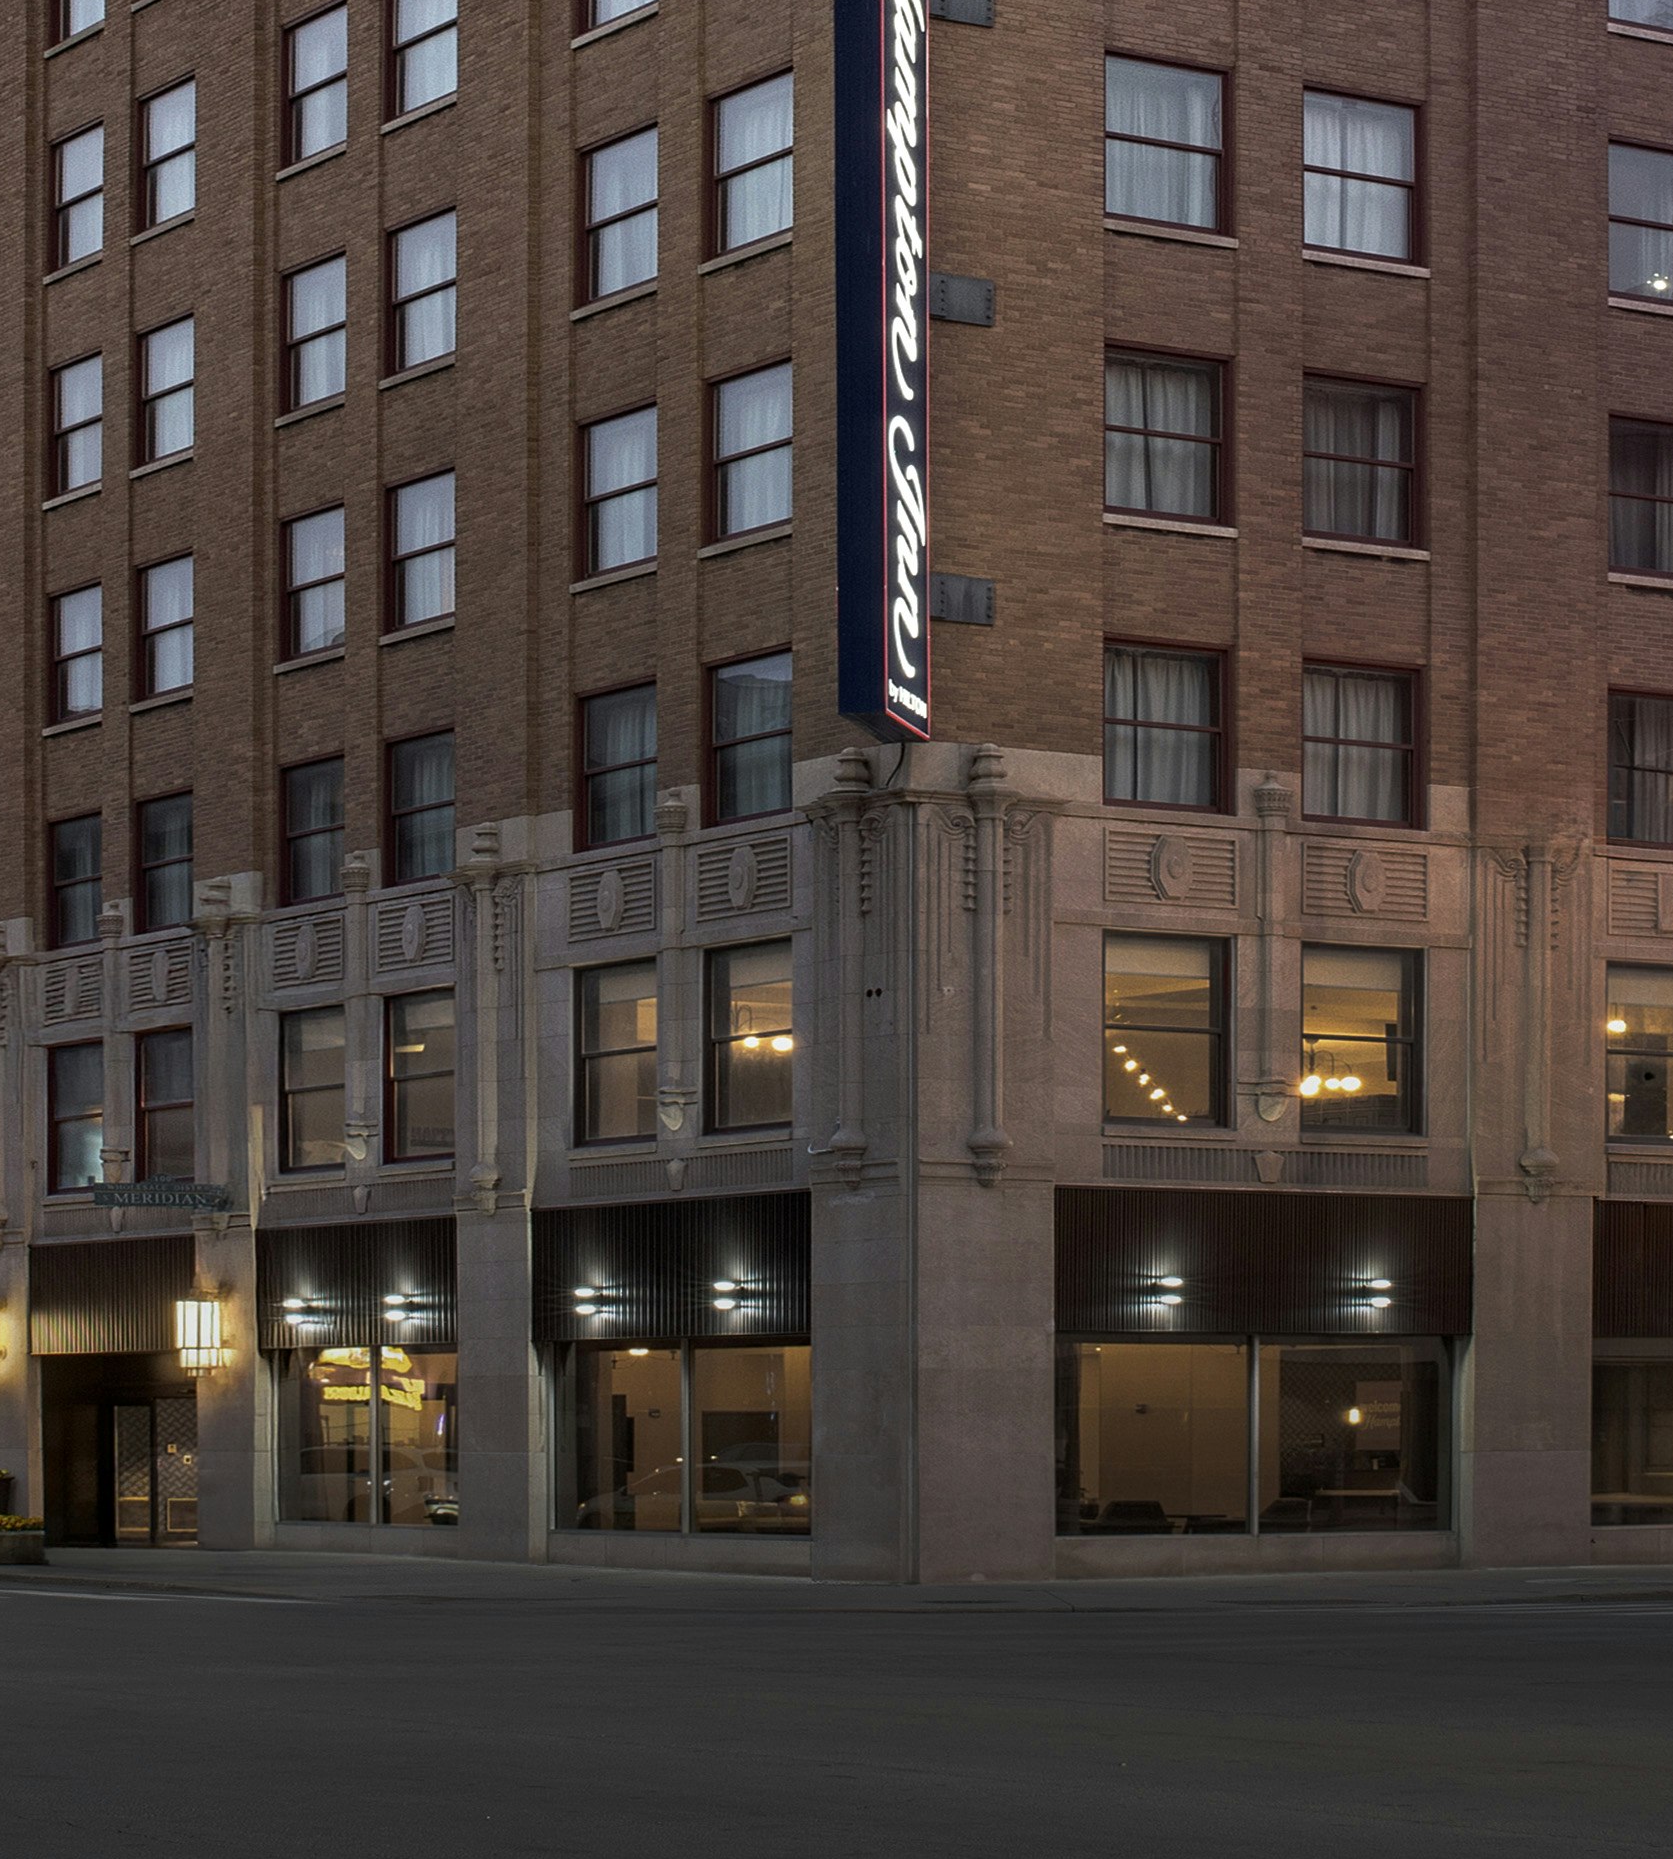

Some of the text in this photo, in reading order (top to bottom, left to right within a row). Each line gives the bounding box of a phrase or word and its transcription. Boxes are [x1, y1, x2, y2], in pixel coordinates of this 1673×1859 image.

[888, 415, 926, 680] Inn
[888, 678, 899, 703] by
[113, 1193, 207, 1205] MERIDIAN
